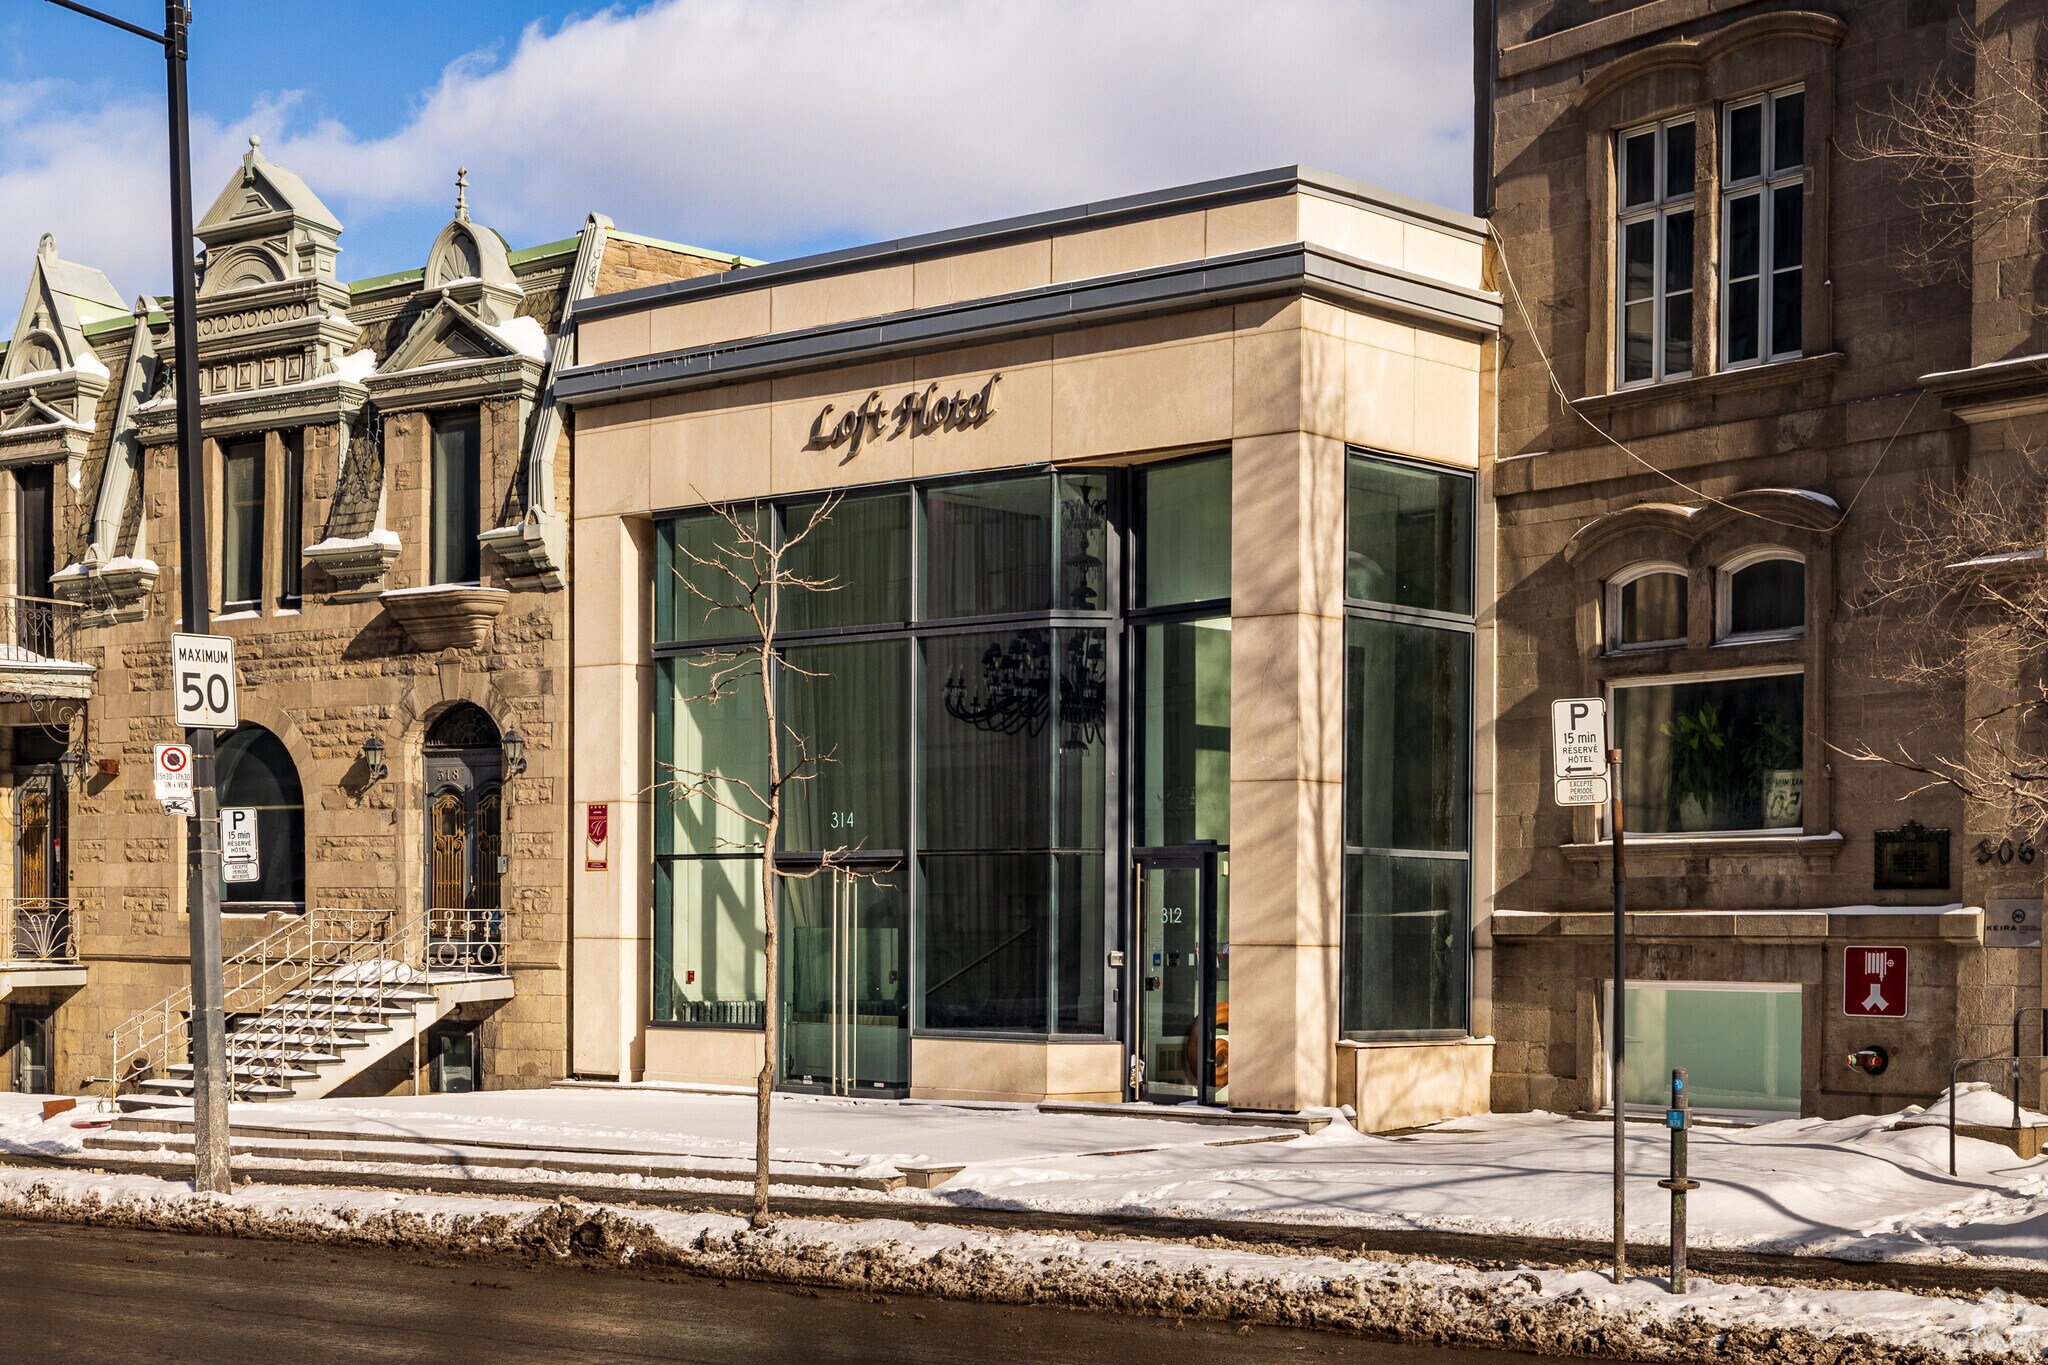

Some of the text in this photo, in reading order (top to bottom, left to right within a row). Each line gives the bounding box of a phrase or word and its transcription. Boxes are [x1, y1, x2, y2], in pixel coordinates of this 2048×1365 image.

[809, 372, 1002, 458] Loft Hotel
[178, 647, 229, 664] MAXIMUM
[182, 672, 229, 714] 50
[1570, 703, 1589, 731] P
[1564, 731, 1597, 744] 15 min
[1562, 744, 1599, 755] RÉSERVÉ
[1568, 755, 1594, 764] HÔTEL
[437, 769, 460, 781] 318
[232, 811, 245, 830] P
[830, 811, 854, 829] 314
[228, 831, 251, 840] 15 min
[1976, 838, 2035, 866] 306
[1160, 907, 1182, 924] 312
